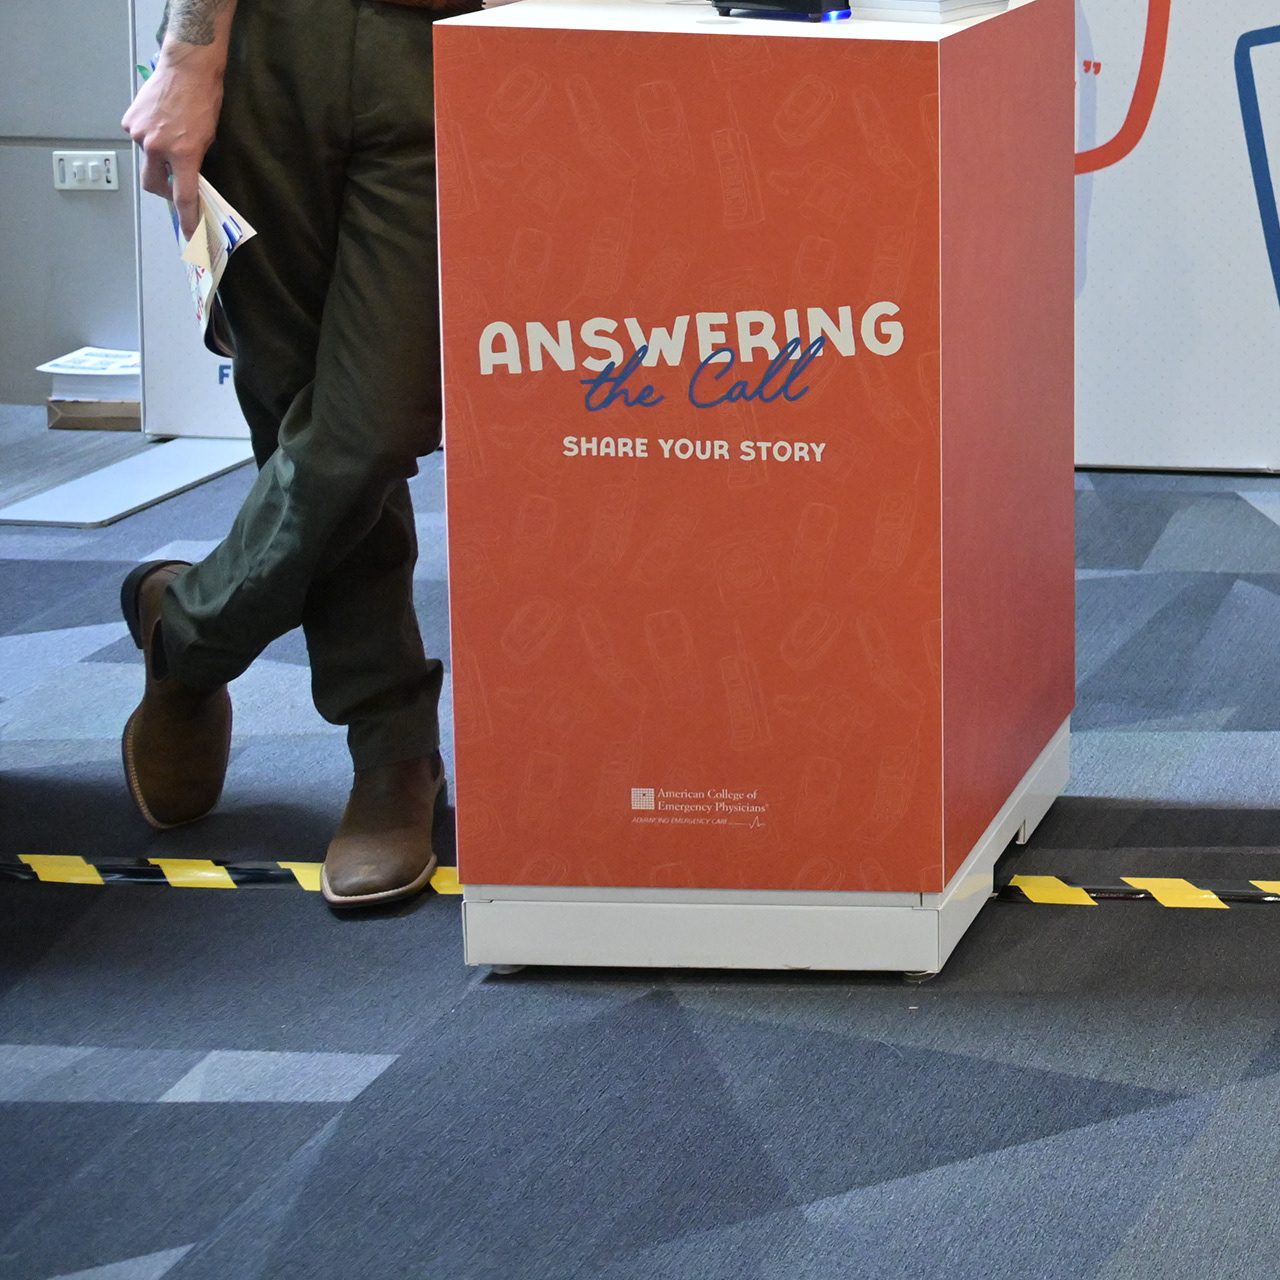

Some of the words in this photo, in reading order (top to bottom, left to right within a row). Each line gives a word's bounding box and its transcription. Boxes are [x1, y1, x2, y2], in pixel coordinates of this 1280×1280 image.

[479, 301, 904, 375] ANSWERING
[579, 344, 664, 412] the
[688, 336, 825, 409] Call
[563, 436, 648, 457] SHARE
[658, 439, 729, 459] YOUR
[740, 441, 825, 461] STORY
[658, 788, 704, 799] American
[707, 789, 744, 801] College
[746, 790, 757, 800] of
[658, 802, 713, 813] Emergency
